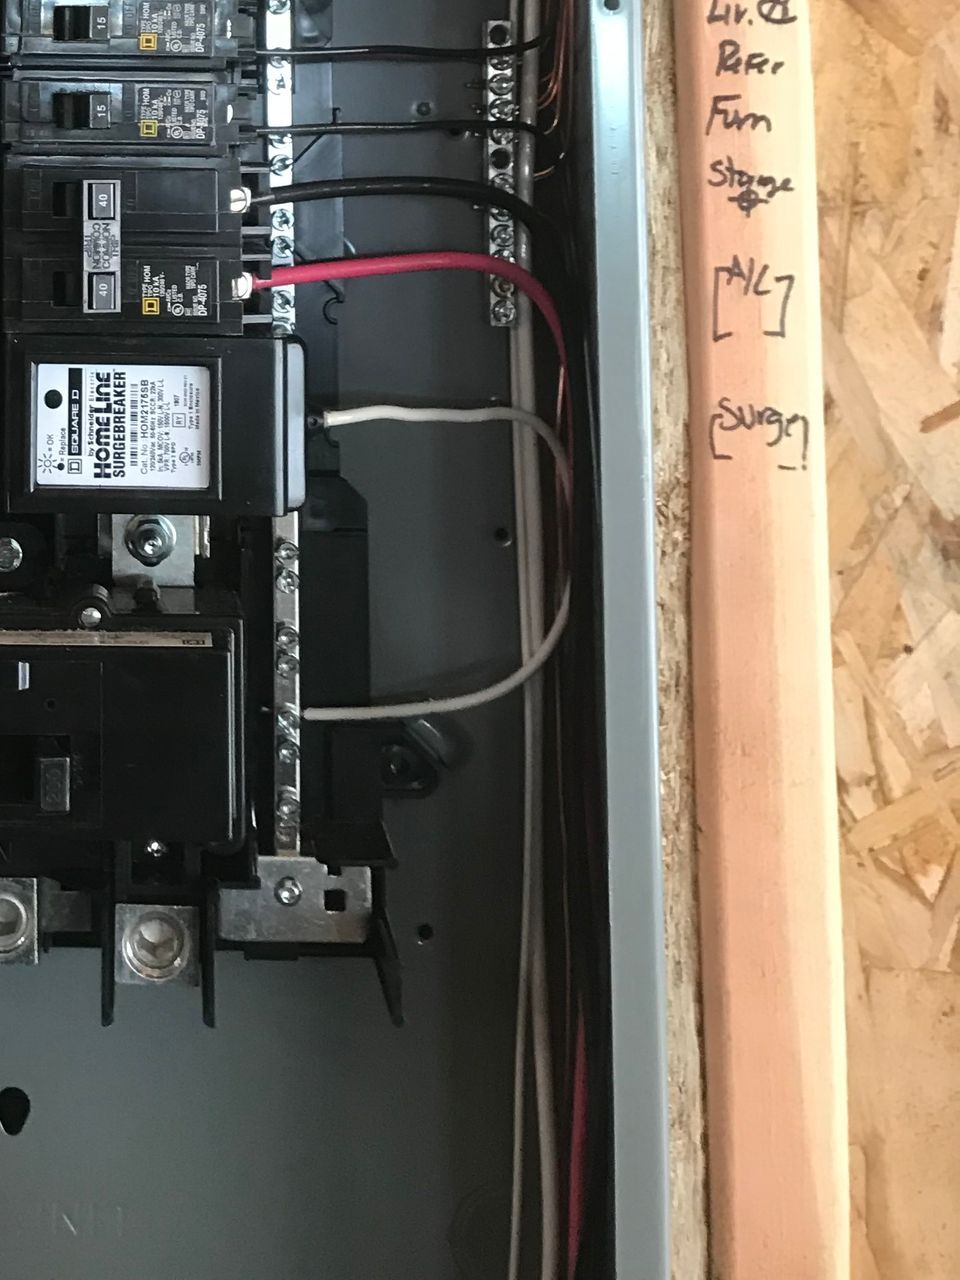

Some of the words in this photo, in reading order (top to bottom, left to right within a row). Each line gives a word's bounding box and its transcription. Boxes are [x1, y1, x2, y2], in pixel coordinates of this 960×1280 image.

[97, 17, 106, 29] 15
[97, 105, 106, 117] 15
[99, 194, 107, 206] 40
[99, 284, 107, 296] 40
[72, 390, 79, 399] D
[113, 372, 126, 477] SURGEBREAKER
[88, 448, 95, 456] by
